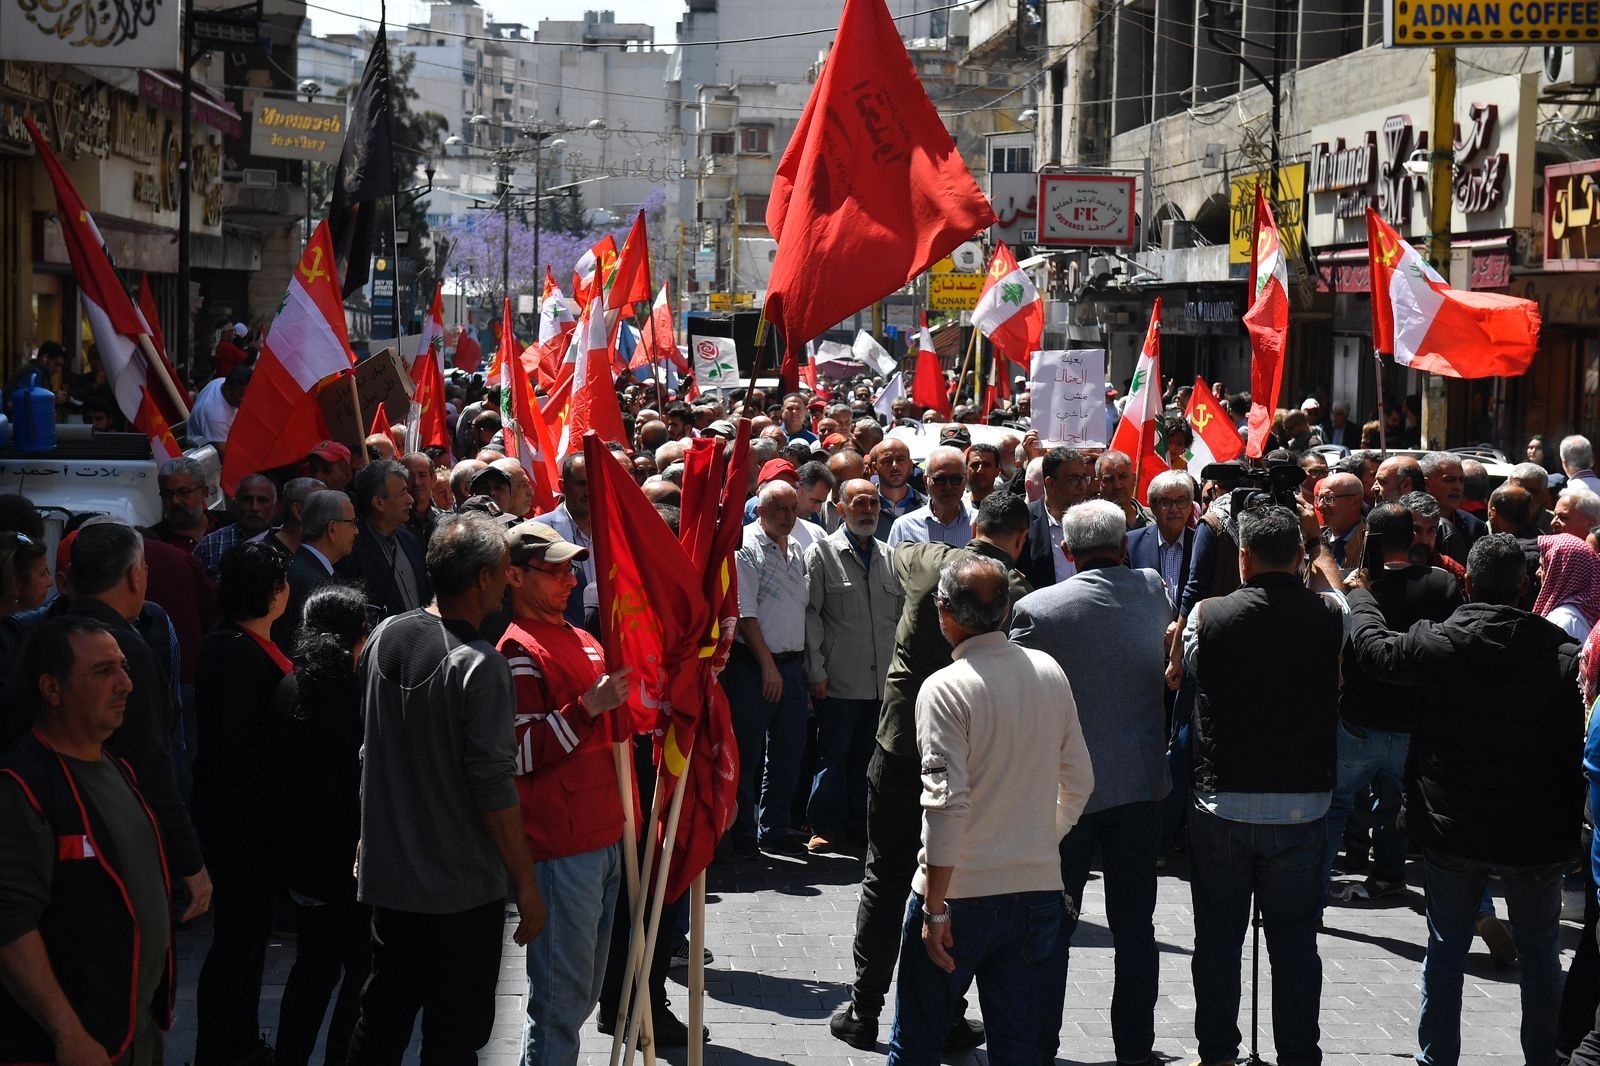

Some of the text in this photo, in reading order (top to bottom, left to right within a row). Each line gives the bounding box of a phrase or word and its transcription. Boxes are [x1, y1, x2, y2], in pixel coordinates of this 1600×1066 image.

[1412, 1, 1600, 26] ADNAN COFFEE
[1074, 207, 1098, 221] FK
[936, 297, 966, 305] ADNAN
[1054, 368, 1088, 386] العمال
[1063, 392, 1088, 401] مش
[1056, 403, 1088, 421] ماشي
[1048, 423, 1088, 445] الحال
